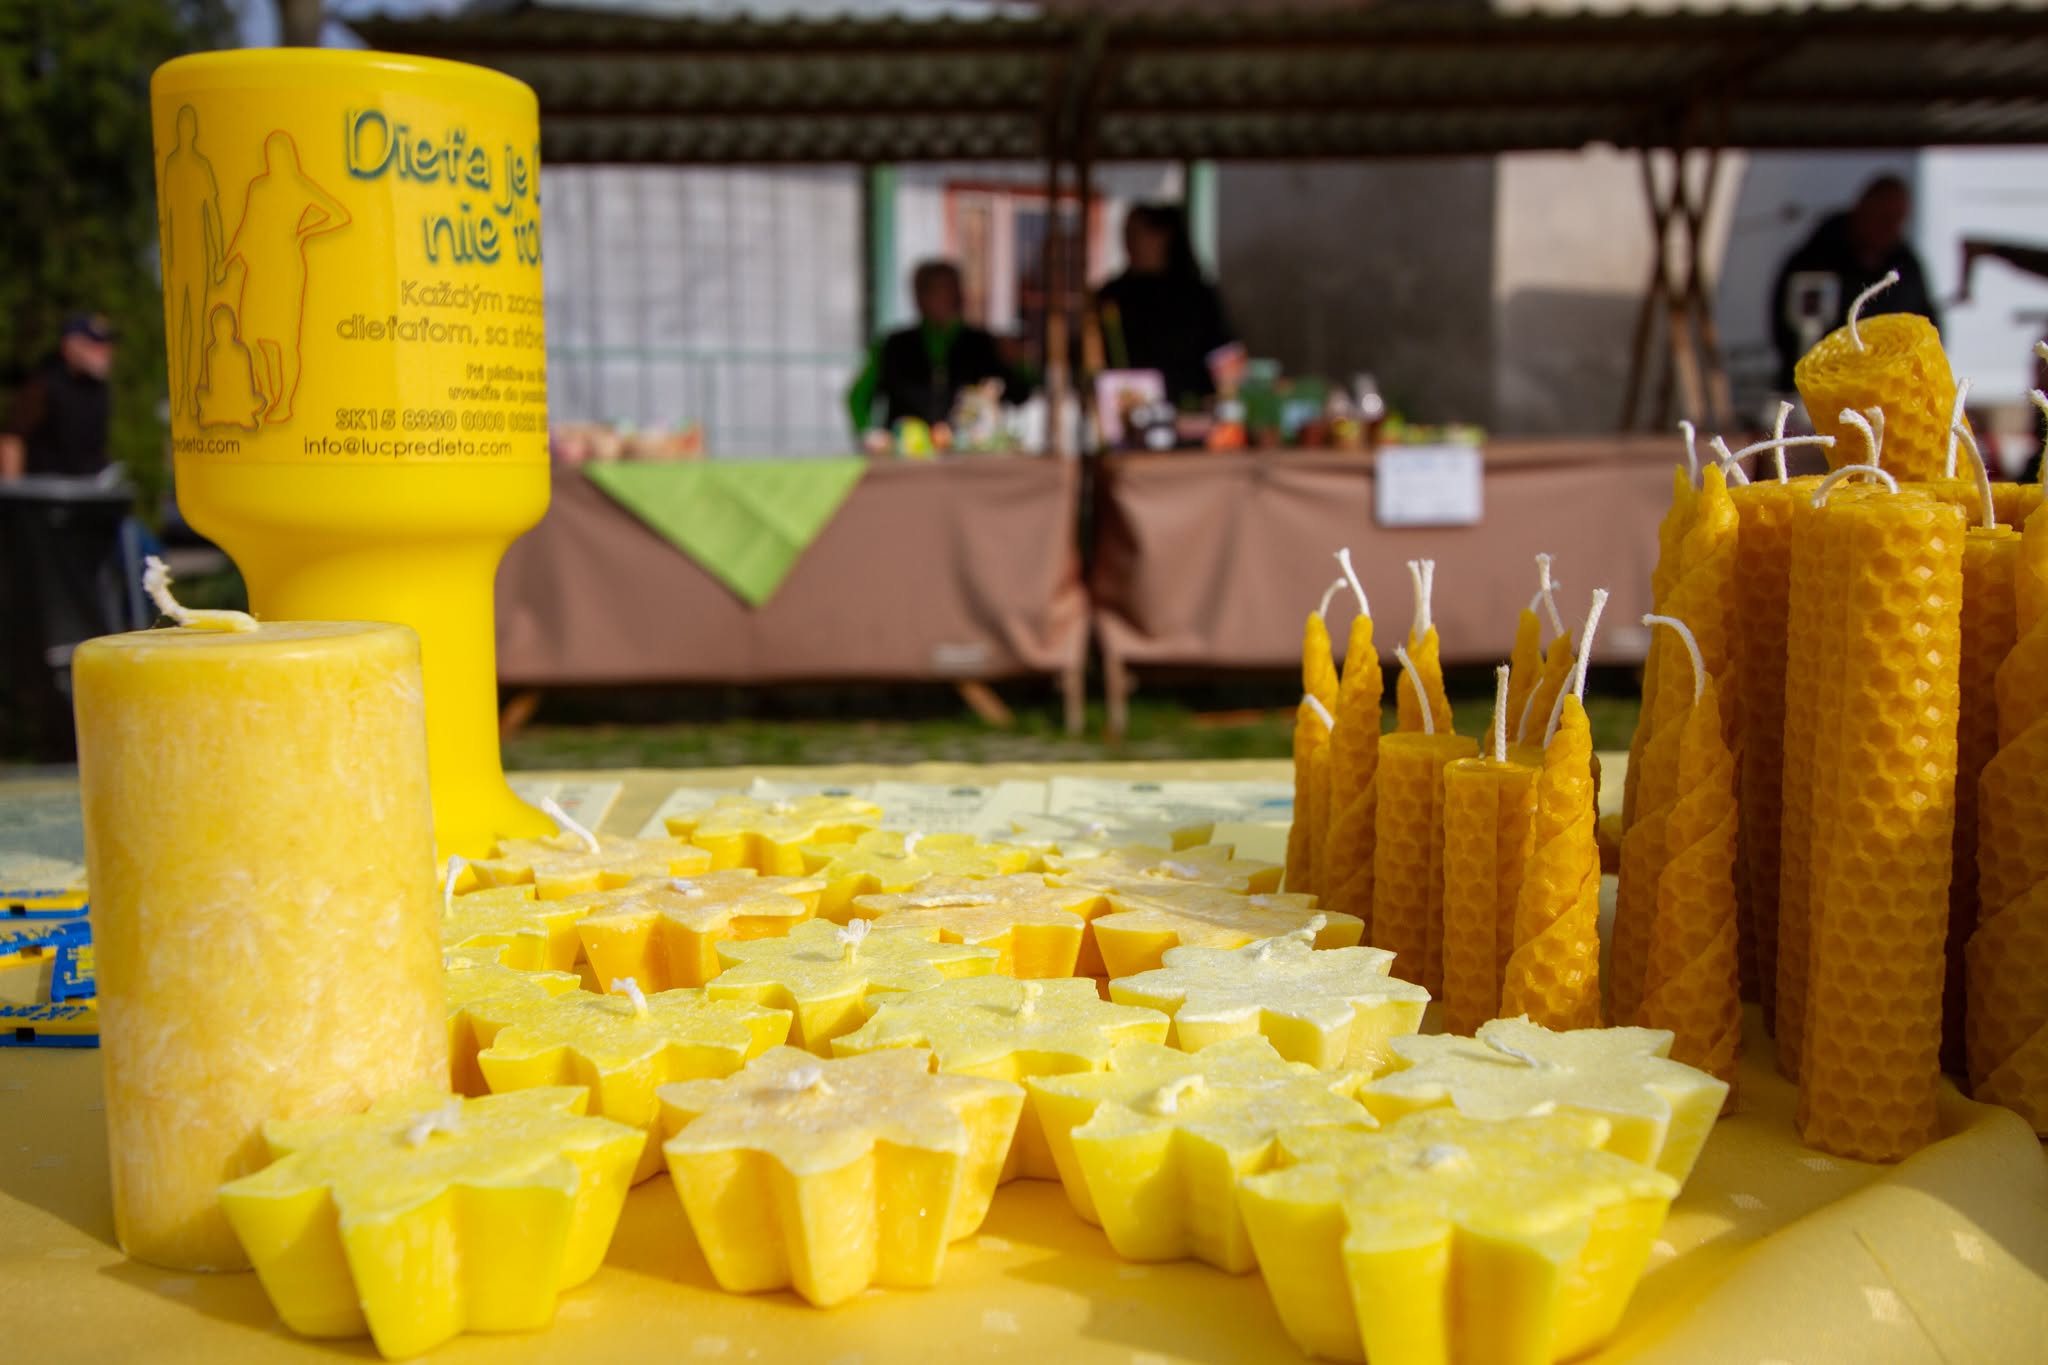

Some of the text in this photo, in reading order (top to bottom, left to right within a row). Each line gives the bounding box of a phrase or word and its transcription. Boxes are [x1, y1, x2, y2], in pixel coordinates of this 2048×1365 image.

[346, 109, 490, 191] Dieťa
[494, 146, 528, 216] je
[423, 203, 501, 264] nie
[400, 281, 503, 315] Každým
[485, 325, 508, 346] sa
[335, 407, 396, 431] SK15
[461, 409, 506, 433] 0000
[303, 435, 512, 458] info@lucpredieta.com
